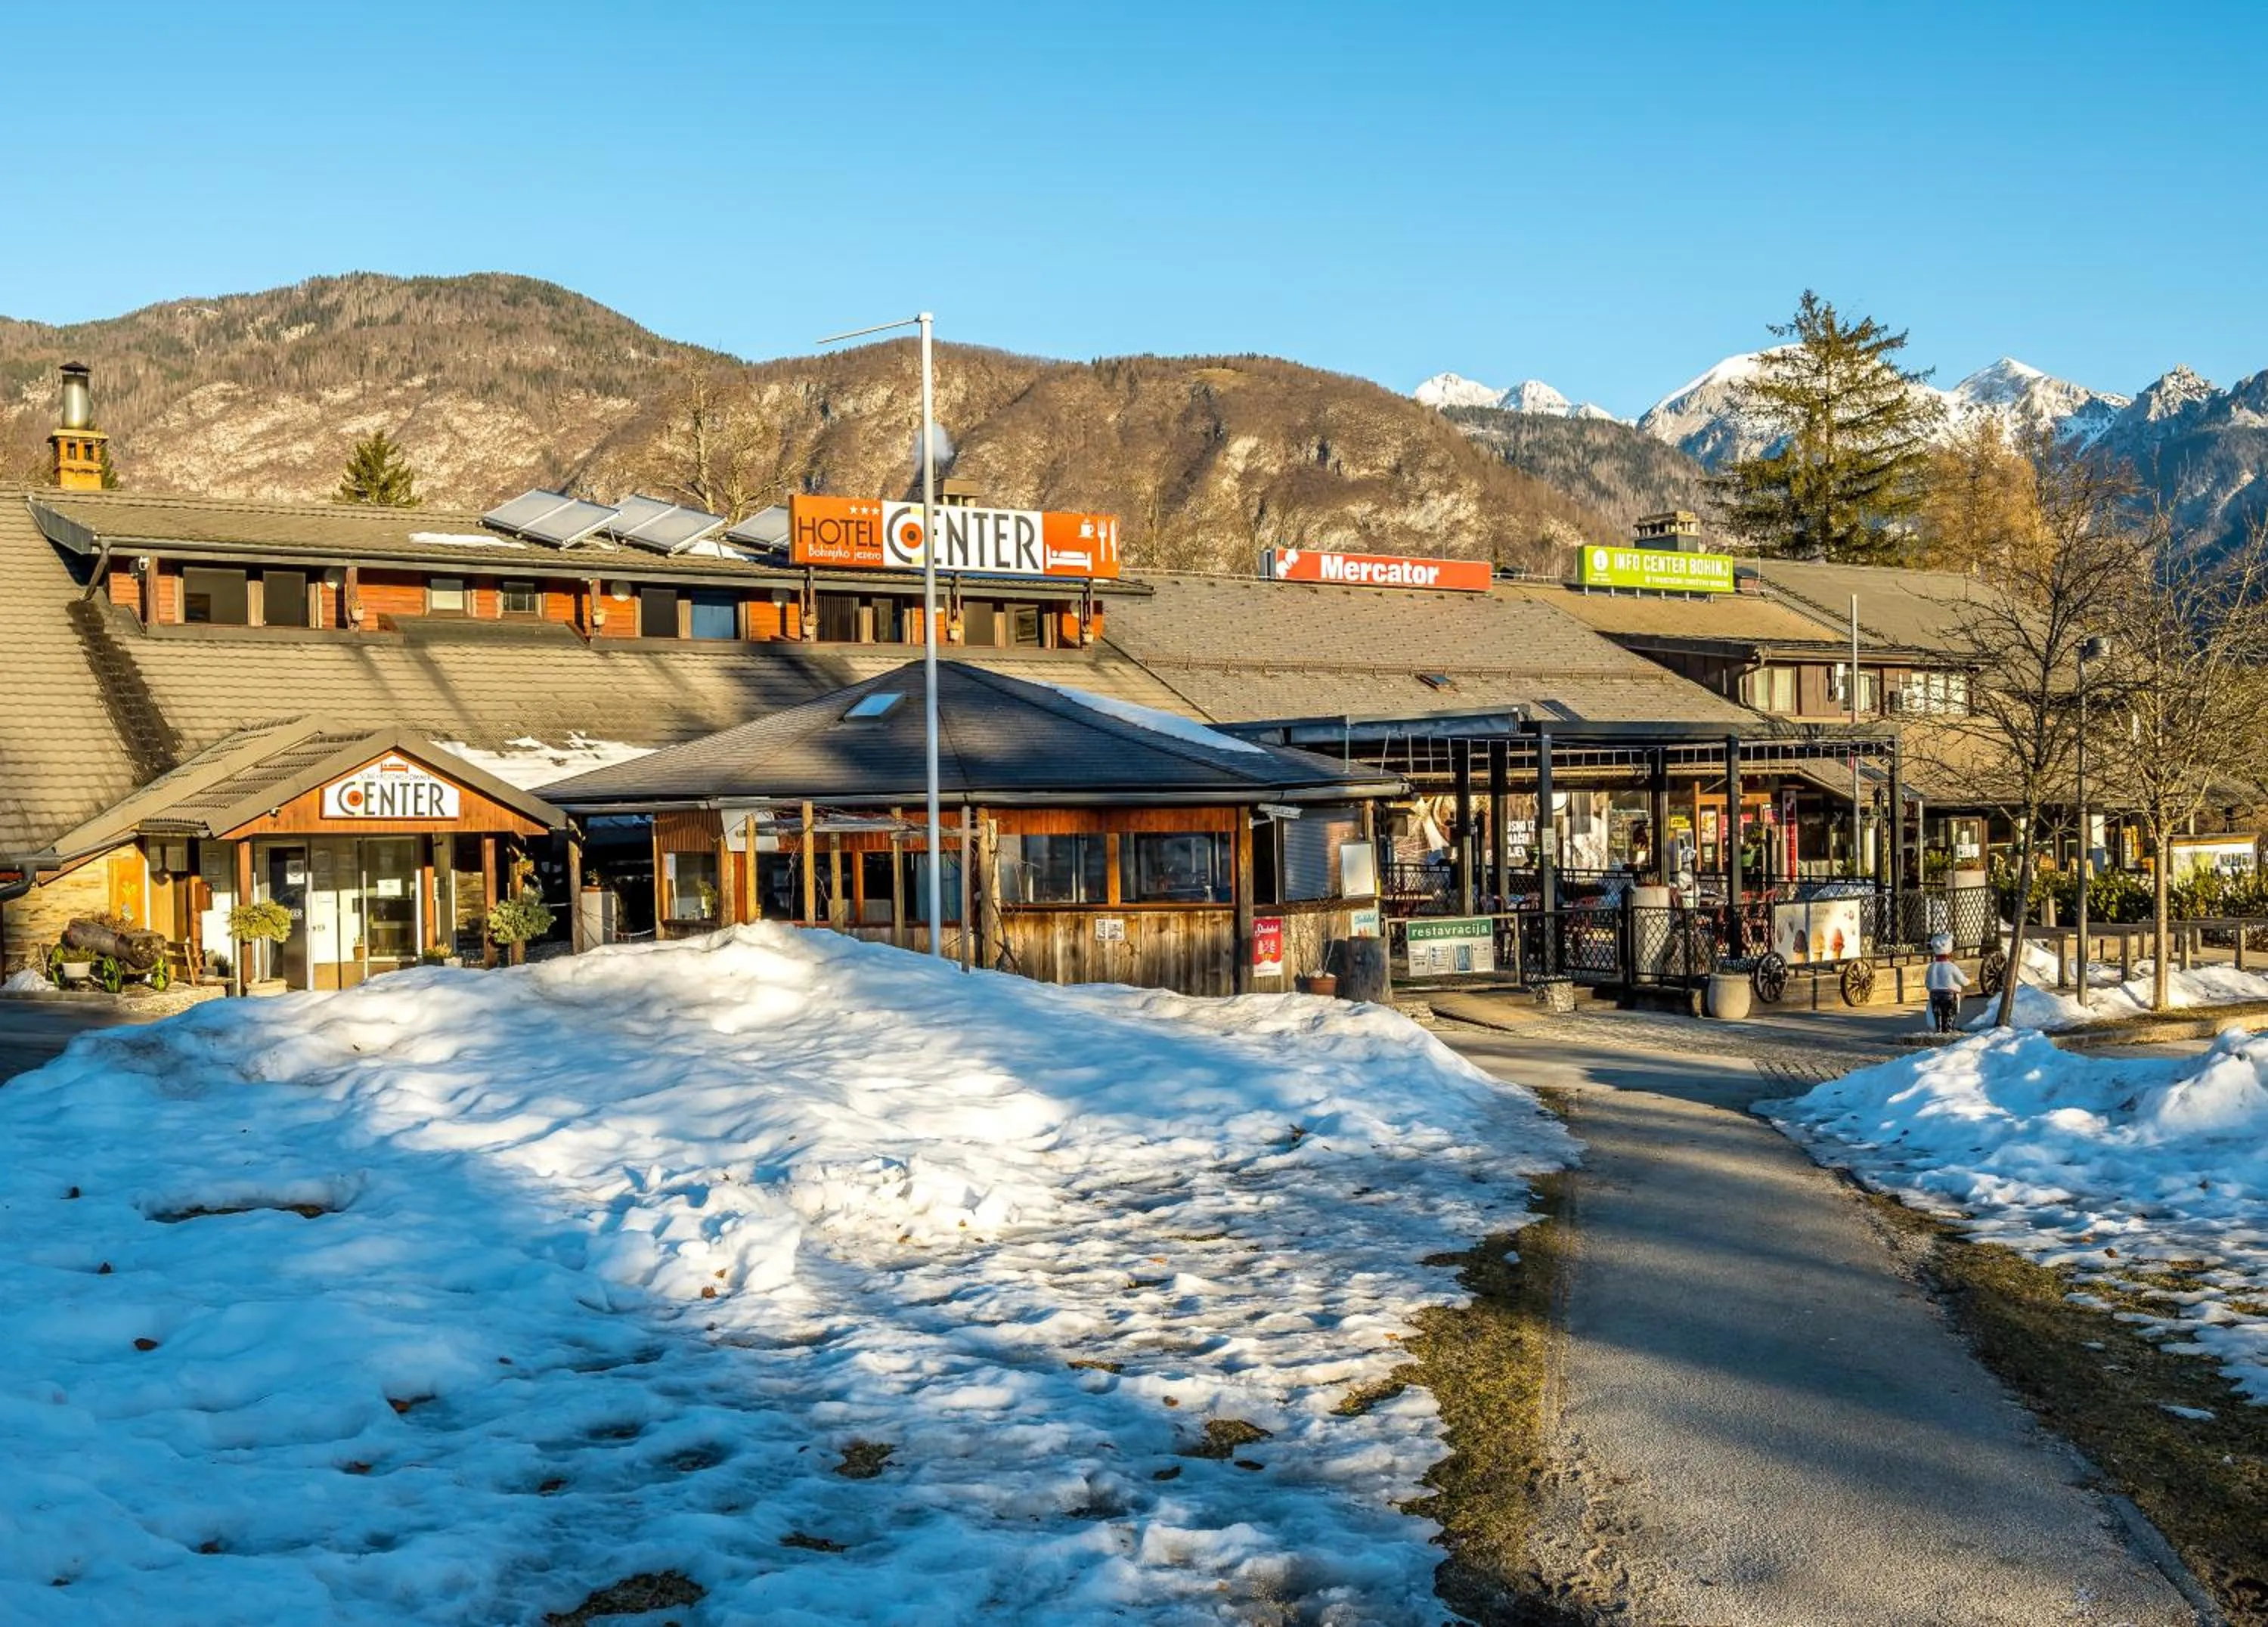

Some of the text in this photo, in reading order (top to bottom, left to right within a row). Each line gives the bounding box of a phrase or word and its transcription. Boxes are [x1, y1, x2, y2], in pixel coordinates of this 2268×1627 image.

[798, 516, 881, 547] HOTEL
[1320, 554, 1439, 585] Mercator
[1613, 553, 1730, 576] INFO CENTER BOHINJ
[336, 781, 446, 817] CENTER
[1411, 923, 1489, 937] restavracija
